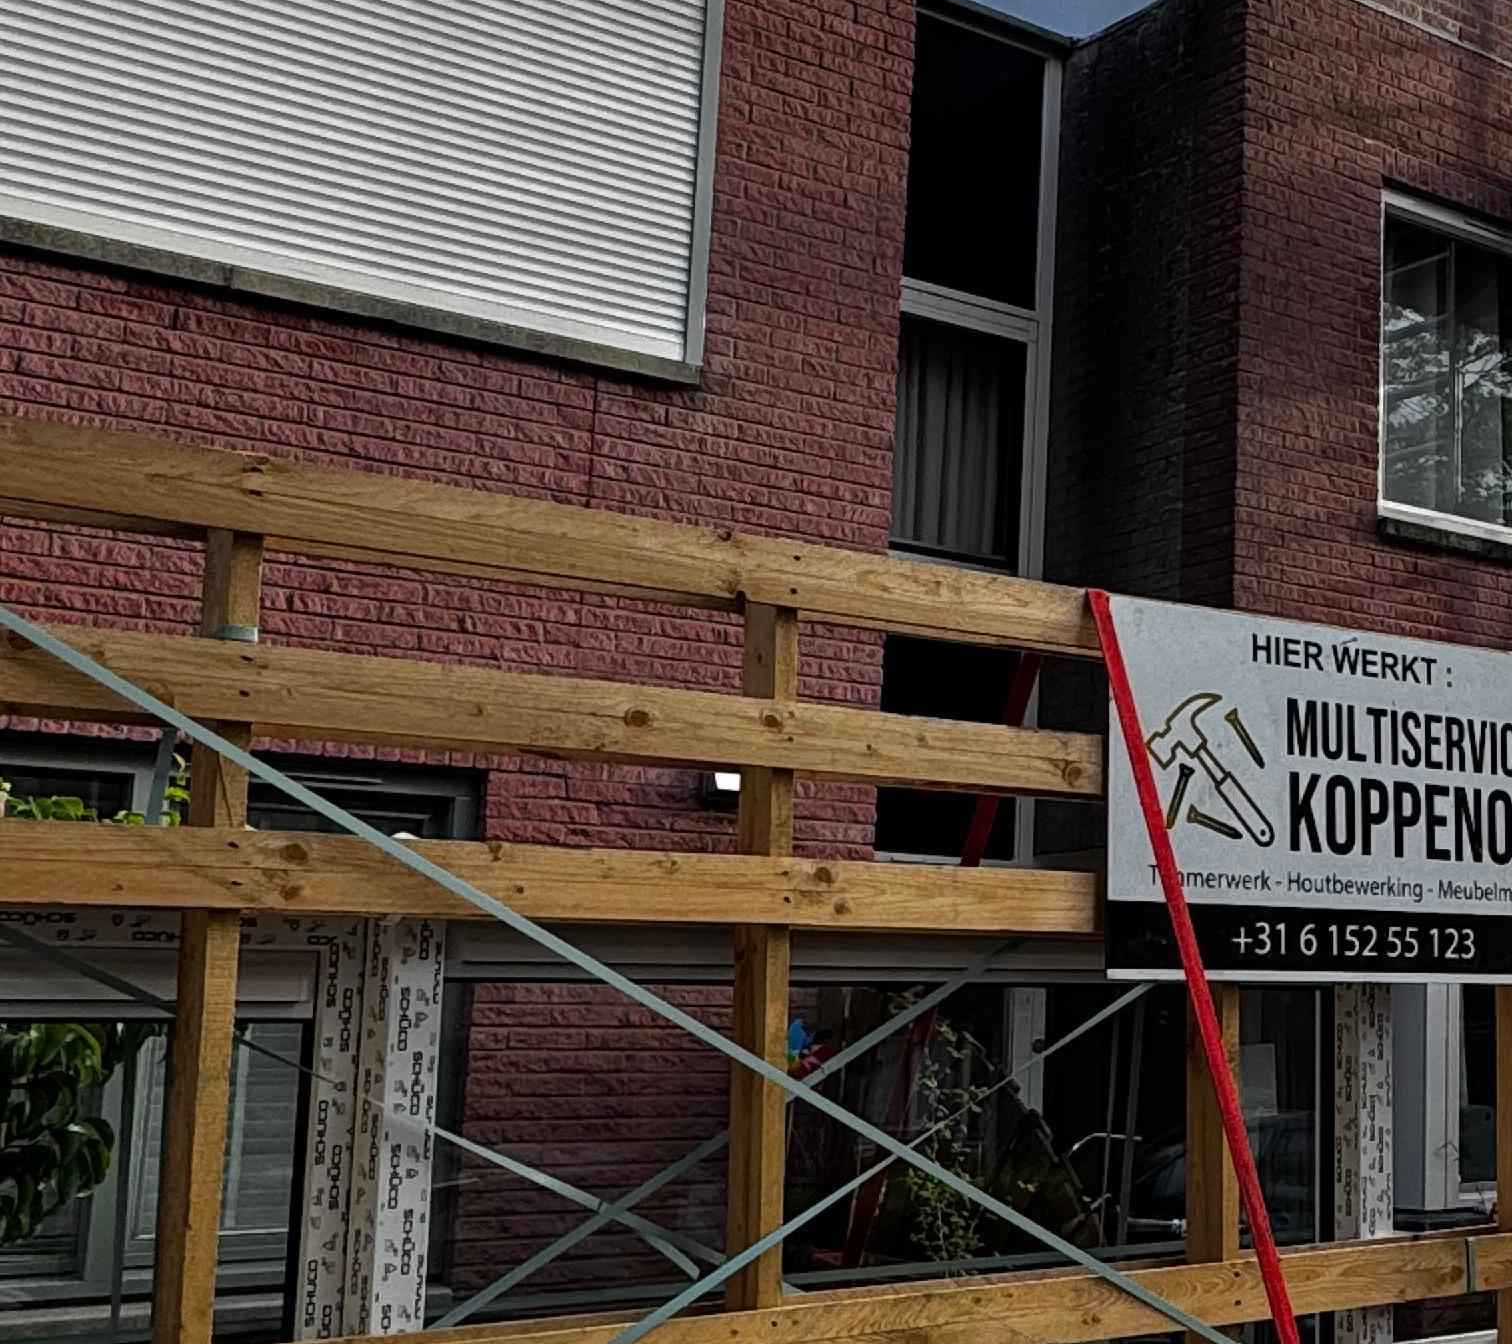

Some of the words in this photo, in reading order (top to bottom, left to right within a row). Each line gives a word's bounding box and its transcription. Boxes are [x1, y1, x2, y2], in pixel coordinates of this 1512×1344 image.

[1252, 633, 1324, 672] HIER
[1332, 644, 1437, 686] WERKT
[1286, 871, 1423, 903] Houtbewerking
[1232, 921, 1286, 955] +31
[1300, 923, 1318, 956] 6
[1328, 924, 1378, 957] 152
[1386, 926, 1419, 958] 55
[1429, 928, 1475, 959] 123
